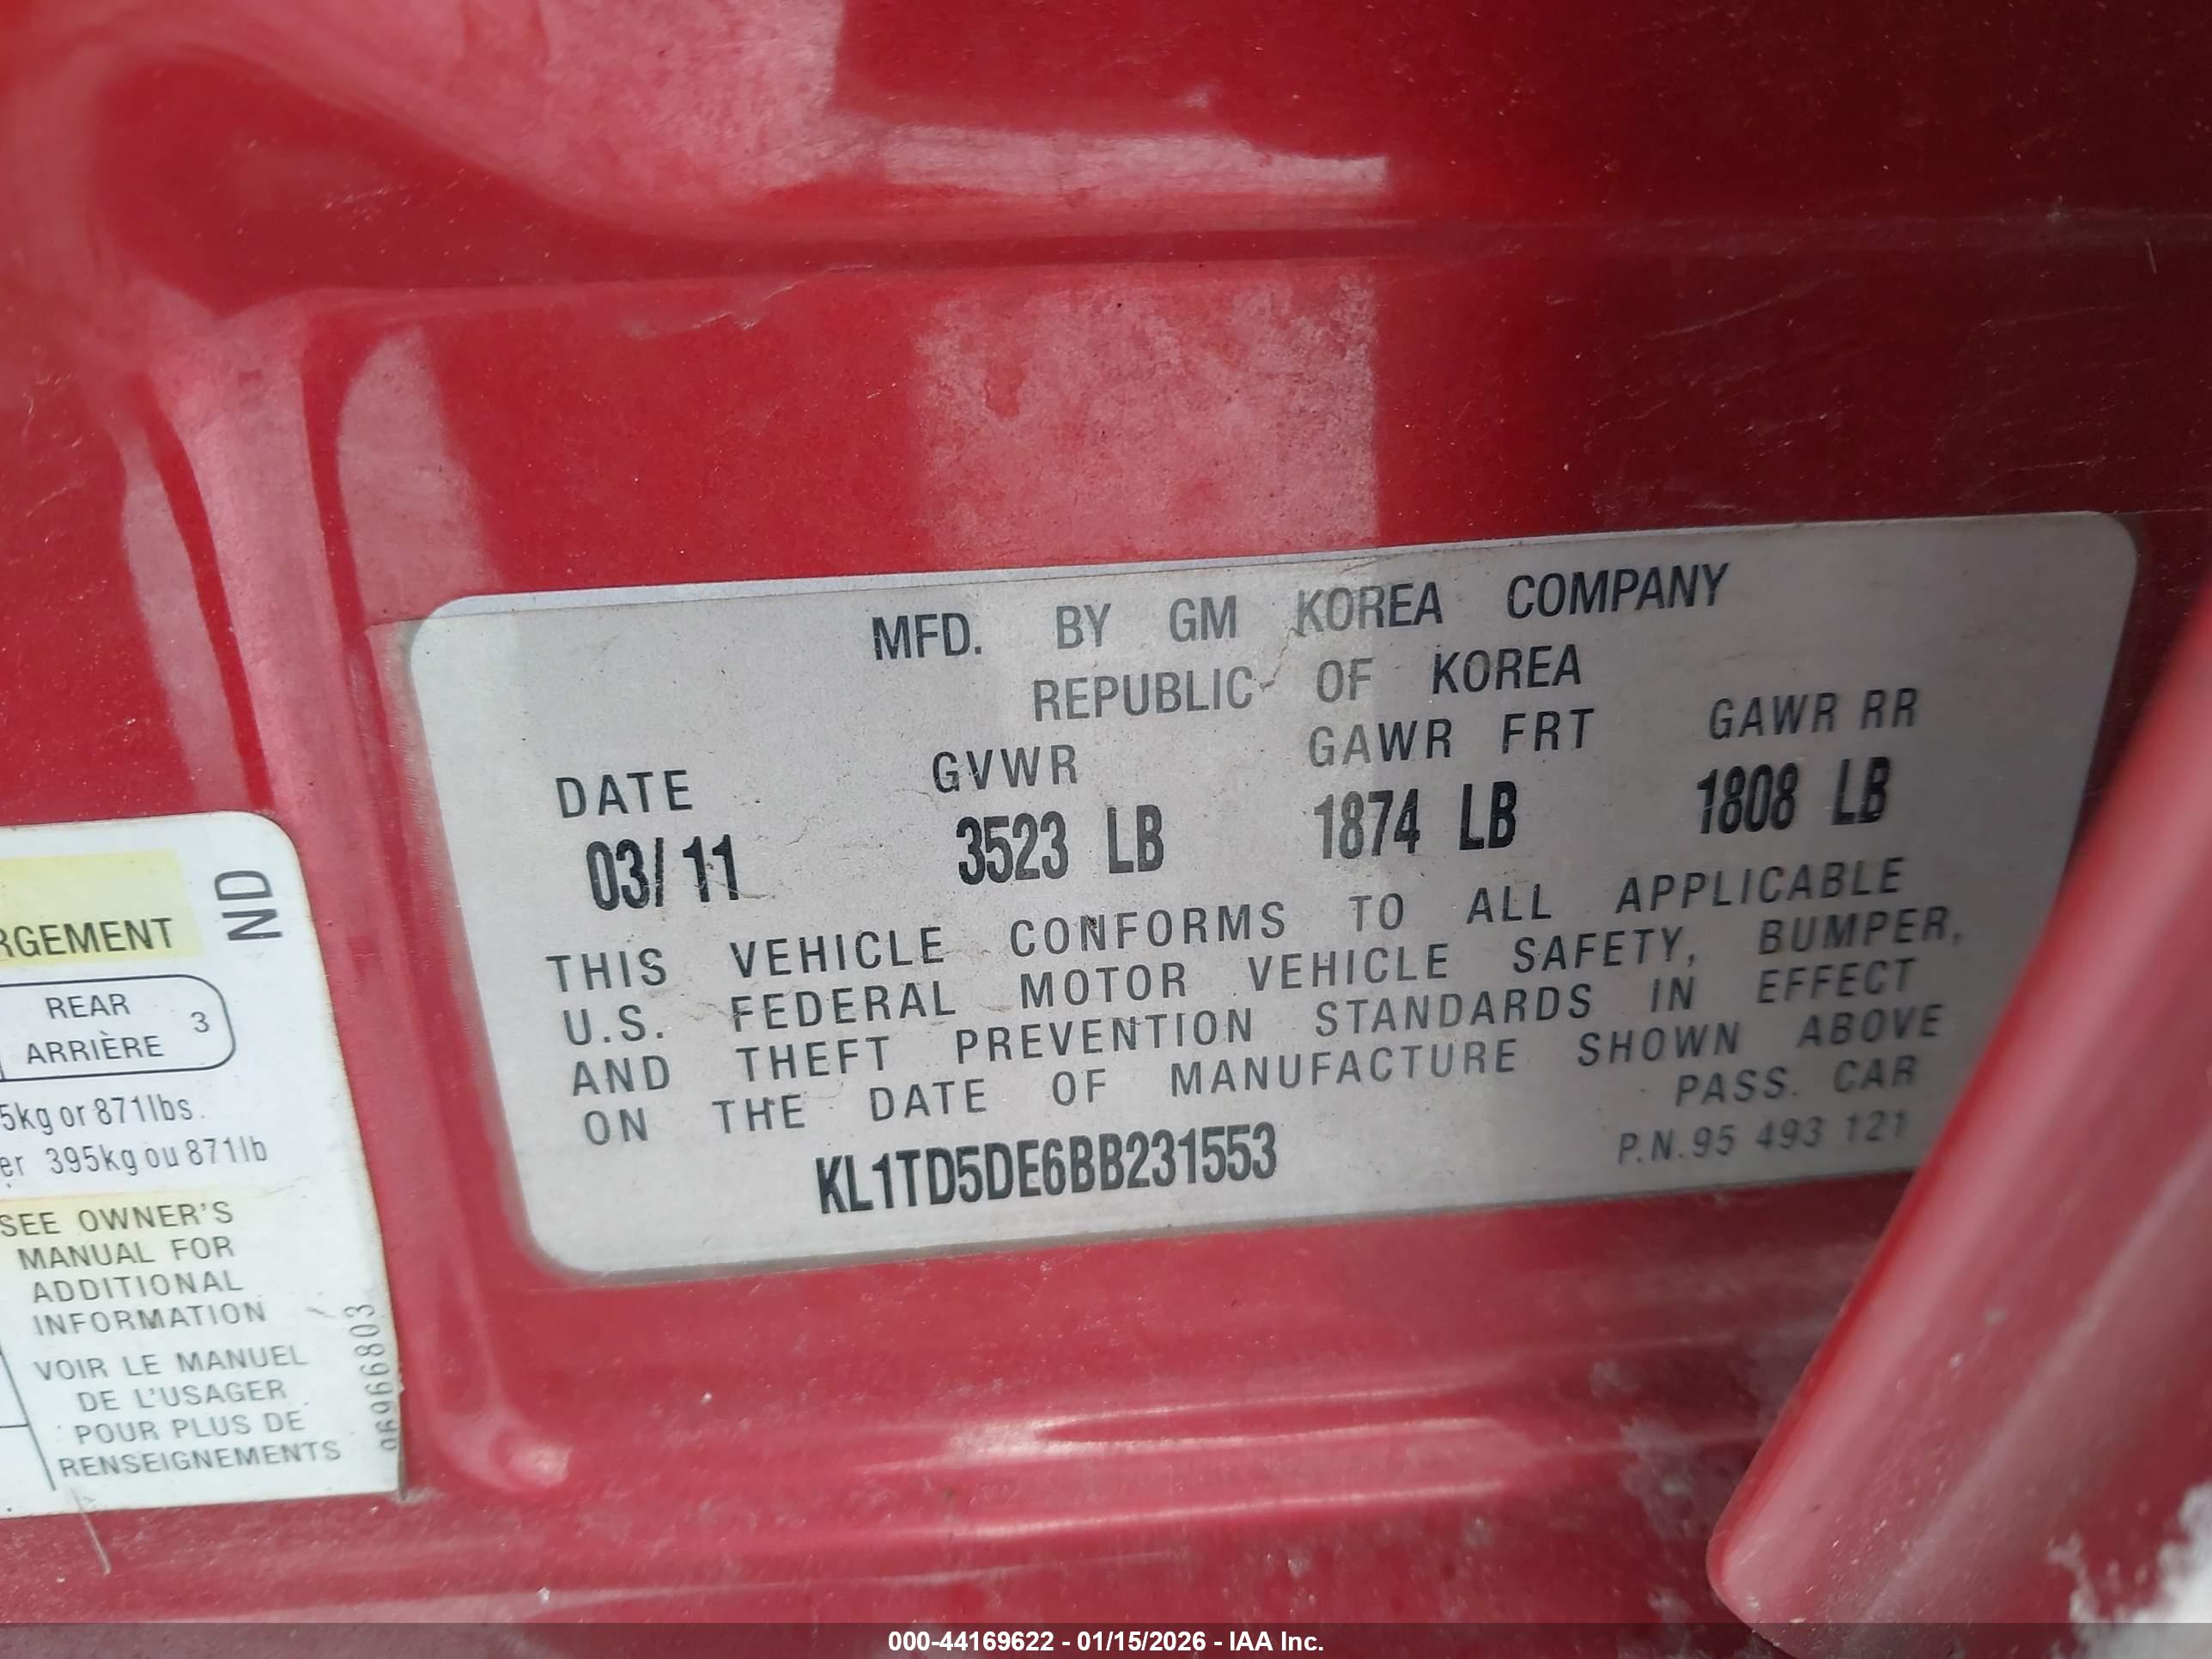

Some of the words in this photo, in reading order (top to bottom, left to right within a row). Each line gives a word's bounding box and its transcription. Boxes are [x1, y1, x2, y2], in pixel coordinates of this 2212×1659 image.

[872, 613, 981, 660] MFD.
[1056, 603, 1111, 649] BY
[1170, 595, 1236, 642] GM
[1295, 581, 1443, 634] KOREA
[1508, 563, 1729, 619] COMPANY
[1034, 666, 1252, 721] REPUBLIC
[1317, 657, 1375, 702] OF
[1432, 644, 1582, 695] KOREA
[1310, 719, 1451, 767] GAWR
[1503, 708, 1594, 753] FRT
[1710, 693, 1837, 739] GAWR
[1862, 688, 1917, 729] RR
[933, 744, 1077, 793] GVWR
[556, 769, 692, 818] DATE
[1697, 763, 1798, 834] 1808
[1832, 757, 1890, 825] LB
[957, 811, 1068, 884] 3523
[1107, 805, 1164, 873] LB
[1314, 788, 1420, 859] 1874
[1459, 781, 1516, 850] LB
[215, 871, 282, 940] ND
[546, 948, 666, 992] THIS
[730, 927, 944, 978] VEHICLE
[1011, 902, 1285, 958] CONFORMS
[1348, 893, 1403, 932] TO
[1467, 884, 1551, 924] ALL
[1616, 857, 1905, 913] APPLICABLE
[563, 1005, 663, 1045] U.S.
[732, 981, 956, 1032] FEDERAL
[1021, 963, 1185, 1009] MOTOR
[1248, 944, 1448, 991] VEHICLE
[1513, 927, 1693, 973] SAFETY,
[1759, 906, 1962, 955] BUMPER,
[46, 994, 130, 1018] REAR
[191, 1012, 209, 1032] 3
[573, 1055, 669, 1096] AND
[736, 1036, 889, 1081] THEFT
[957, 1008, 1253, 1065] PREVENTION
[1315, 982, 1591, 1037] STANDARDS
[1651, 977, 1693, 1012] IN
[1758, 958, 1915, 1003] EFFECT
[28, 1031, 163, 1064] ARRIÈRE
[585, 1108, 647, 1145] ON
[712, 1093, 805, 1133] THE
[870, 1079, 986, 1121] DATE
[1053, 1068, 1105, 1106] OF
[1171, 1039, 1516, 1097] MANUFACTURE
[1578, 1023, 1738, 1066] SHOWN
[1797, 1004, 1942, 1047] ABOVE
[1676, 1066, 1800, 1107] PASS.
[1834, 1055, 1917, 1093] CAR
[60, 1106, 85, 1127] or
[1756, 1116, 1823, 1150] 493
[1847, 1110, 1905, 1141] 121
[46, 1145, 137, 1176] 395kg
[145, 1147, 179, 1168] ou
[185, 1136, 266, 1165] 871lb
[816, 1122, 1276, 1214] KL1TD5DE6BB231553
[0, 1212, 60, 1237] SEE
[78, 1201, 233, 1231] OWNER'S
[17, 1243, 155, 1269] MANUAL
[171, 1237, 233, 1260] FOR
[33, 1271, 244, 1304] ADDITIONAL
[34, 1303, 264, 1335] INFORMATION
[34, 1358, 107, 1381] VOIR
[123, 1354, 161, 1376] LE
[176, 1346, 307, 1372] MANUEL
[77, 1390, 119, 1412] DE
[135, 1380, 286, 1408] L'USAGER
[75, 1421, 158, 1444] POUR
[172, 1415, 251, 1438] PLUS
[264, 1411, 304, 1432] DE
[58, 1441, 340, 1477] RENSEIGNEMENTS
